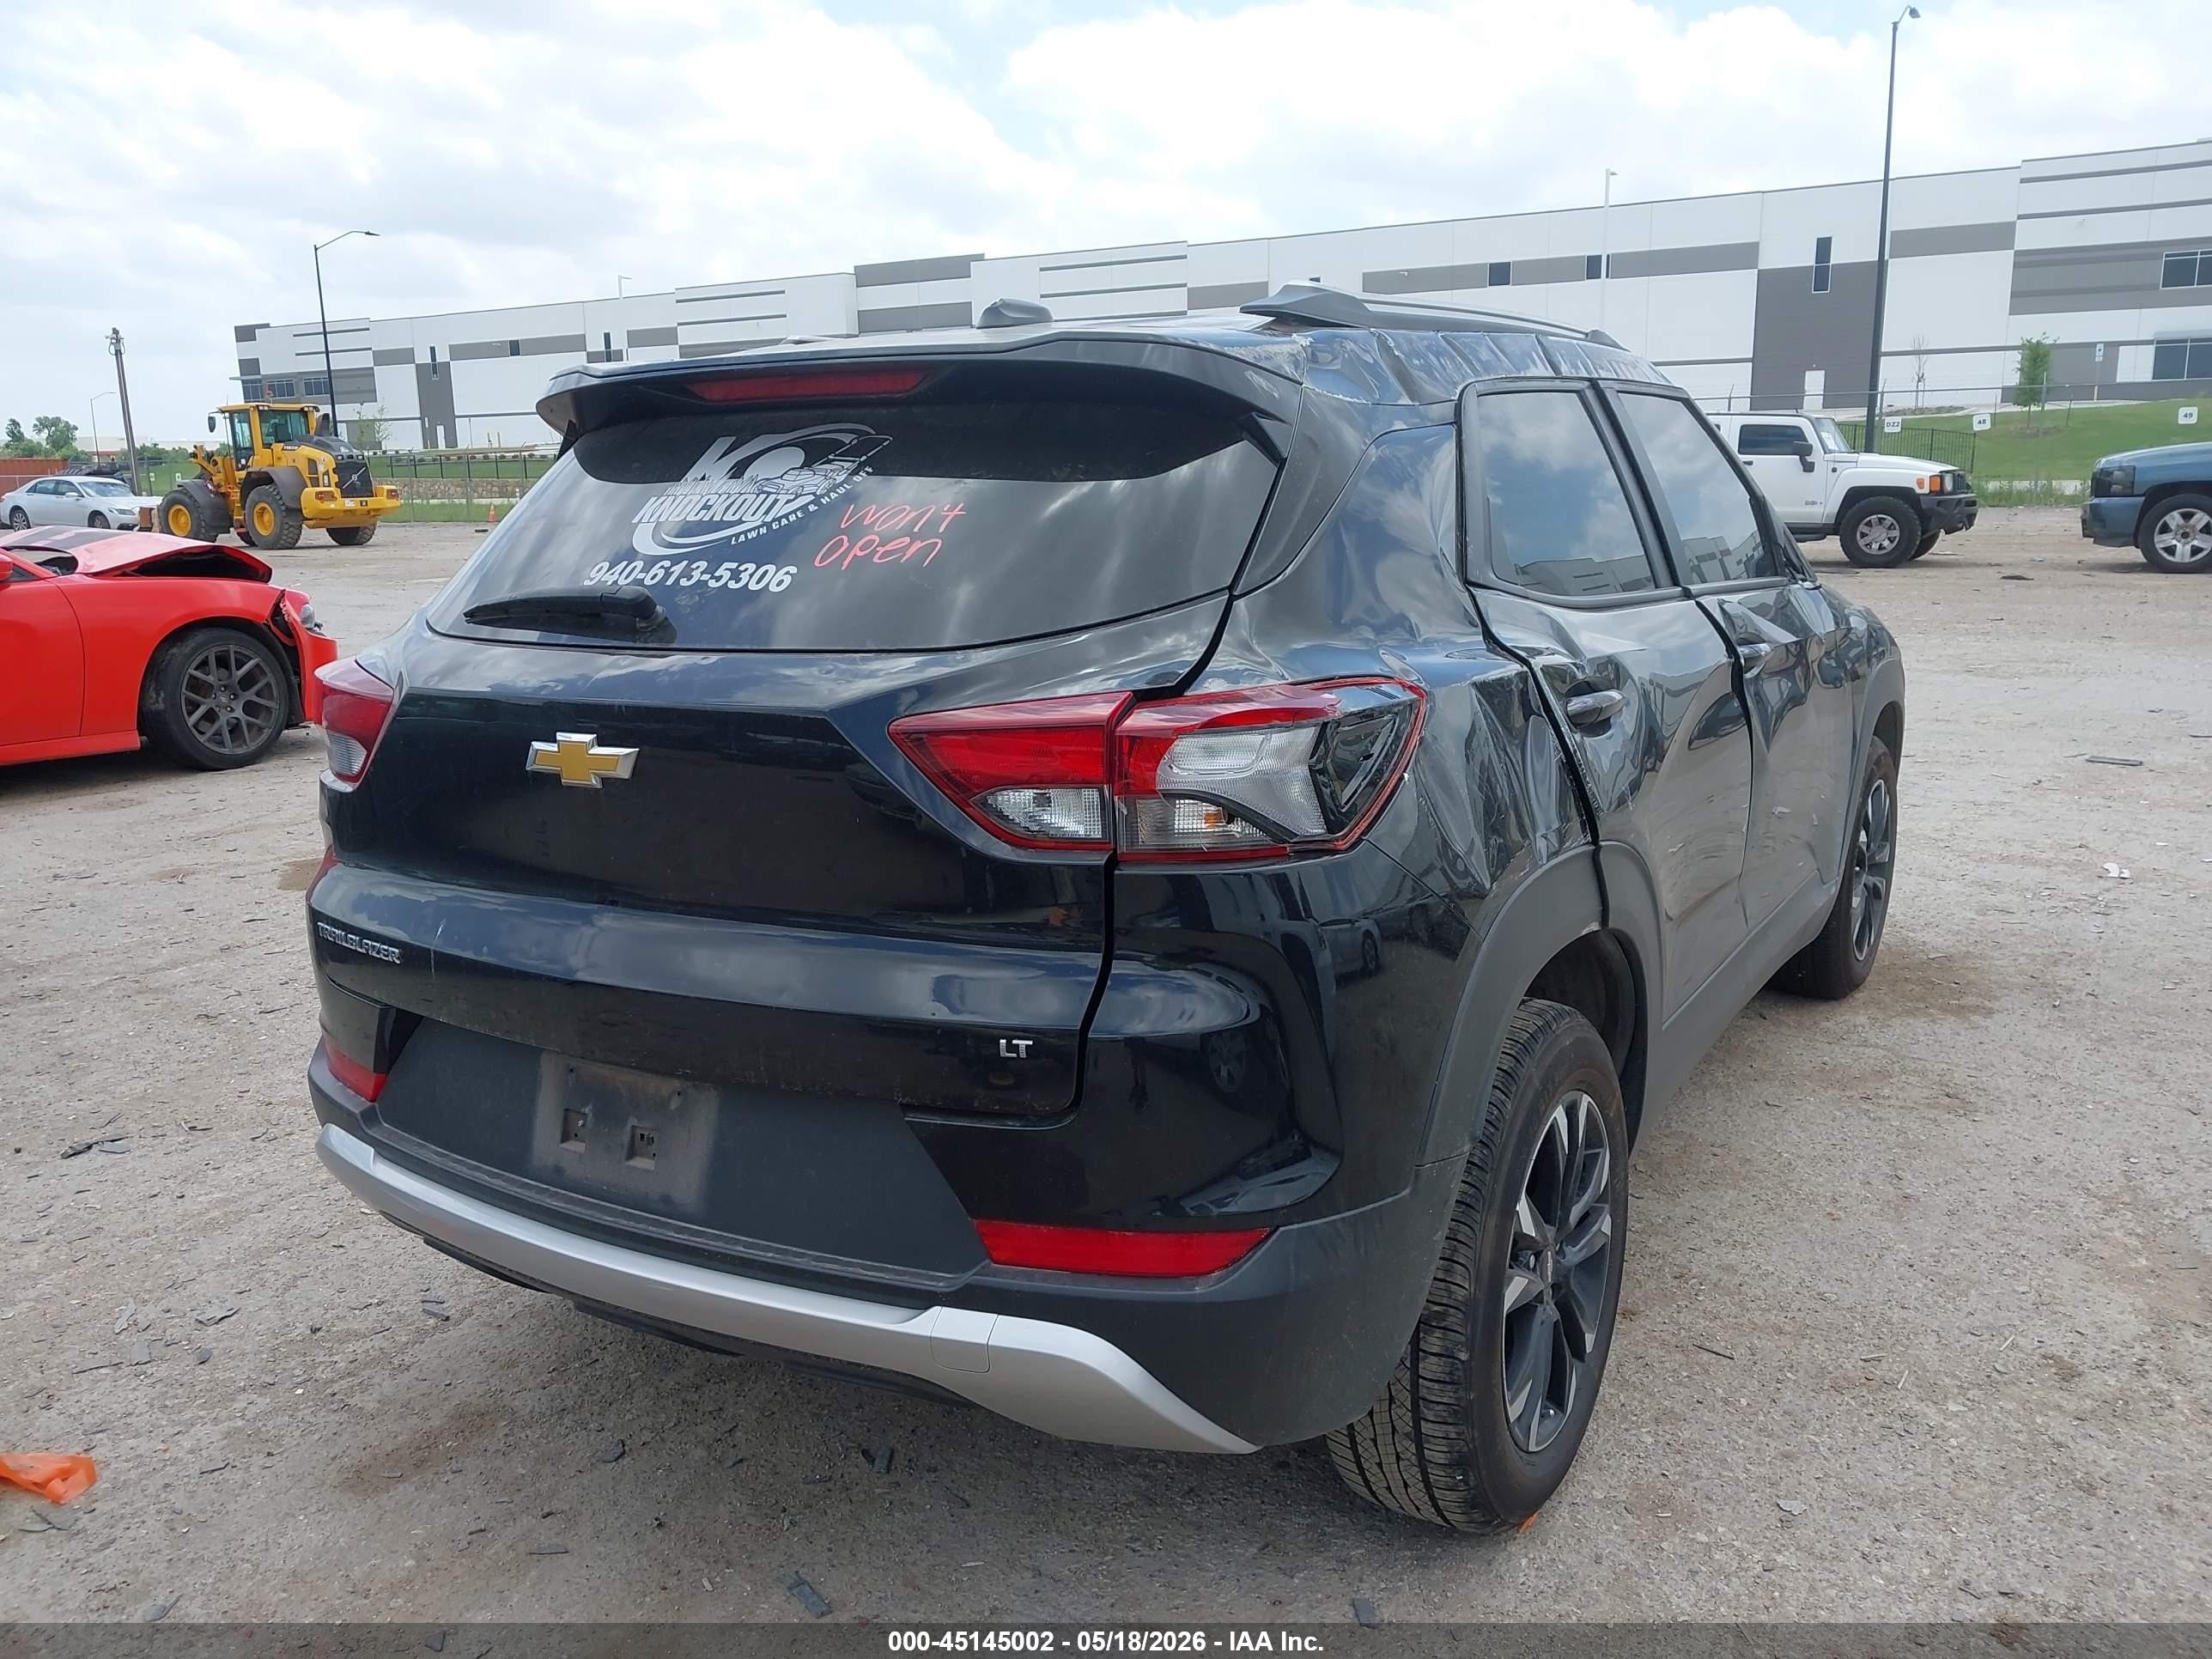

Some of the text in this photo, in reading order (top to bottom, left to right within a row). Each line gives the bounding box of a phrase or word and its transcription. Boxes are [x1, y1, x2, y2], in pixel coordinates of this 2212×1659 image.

[631, 494, 796, 523] KNOCKOUT
[731, 465, 874, 545] LAWN CARE & HAUL OFF
[584, 560, 798, 592] 940-613-5306
[317, 921, 401, 964] TRAILBLAZER
[1000, 1039, 1033, 1058] LT
